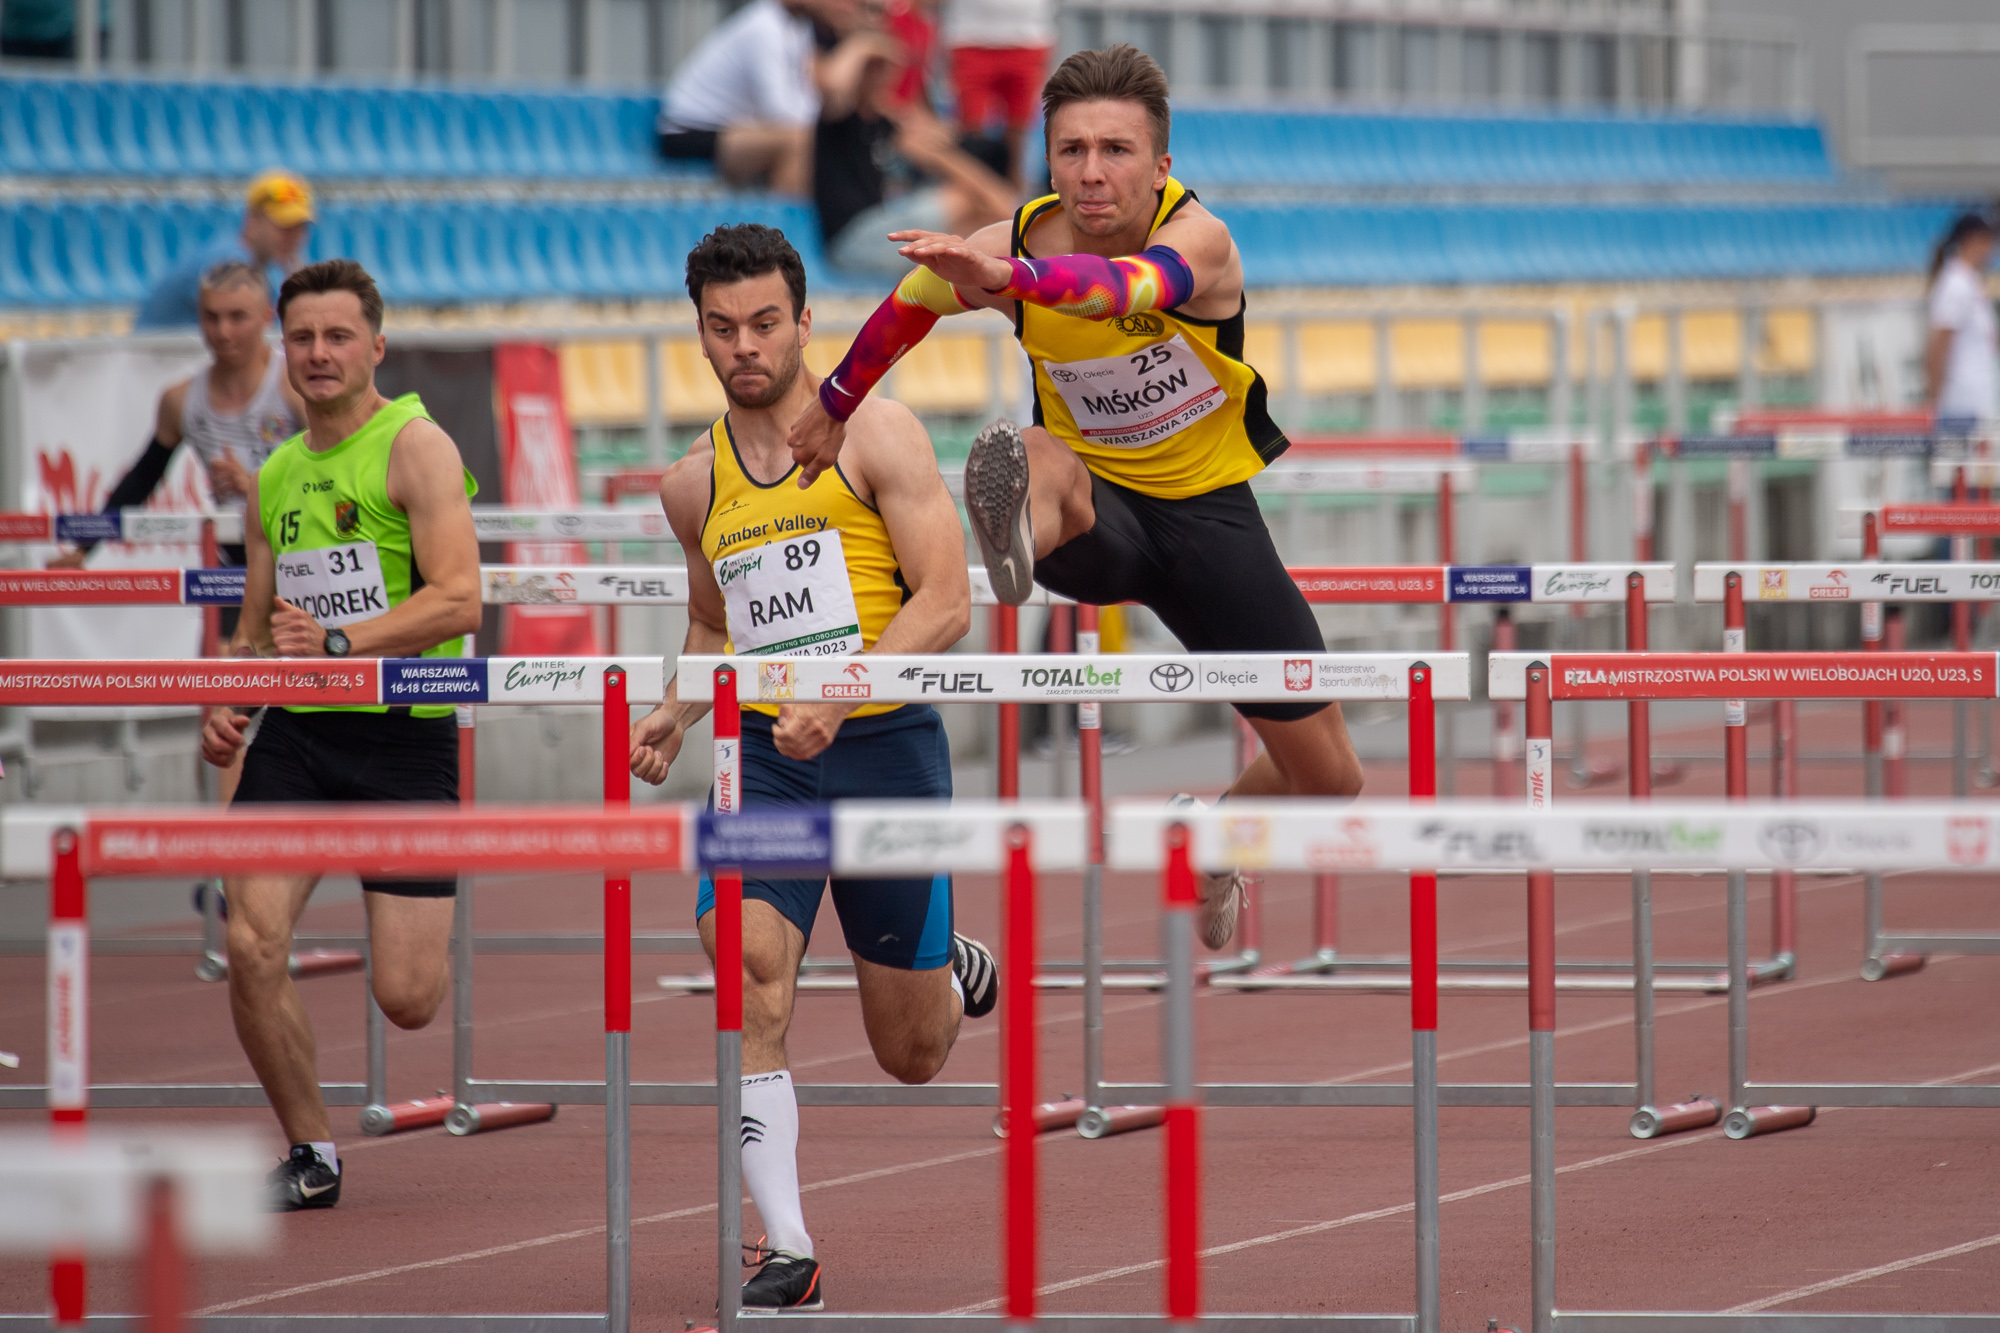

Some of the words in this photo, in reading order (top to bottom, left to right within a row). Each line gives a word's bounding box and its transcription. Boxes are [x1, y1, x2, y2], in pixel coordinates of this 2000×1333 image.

[1130, 345, 1172, 377] 25
[1083, 368, 1115, 379] Okęcie
[1081, 368, 1189, 416] MIŚKÓW
[1099, 419, 1181, 446] WARSZAWA
[1182, 400, 1214, 421] 2023
[1138, 411, 1154, 420] U23
[1140, 420, 1159, 430] POLSKI
[280, 509, 302, 546] 15
[717, 523, 769, 550] Amber
[774, 514, 828, 532] Valley
[328, 548, 364, 576] 31
[784, 539, 821, 571] 89
[284, 563, 314, 578] FUEL
[22, 580, 104, 592] WIELOBOJACH
[199, 575, 246, 584] WARSZAW
[1463, 574, 1516, 583] WARSZAWA
[1889, 578, 1948, 594] FUEL
[616, 581, 673, 597] FUEL
[1480, 585, 1526, 595] CZERWCA
[1810, 588, 1848, 598] ORLEN
[284, 586, 384, 619] CIOREK
[748, 587, 814, 628] RAM
[774, 640, 798, 650] MITYNG
[799, 628, 850, 645] WIELOBOJOWY
[814, 641, 848, 656] 2023
[531, 661, 565, 669] INTER
[1319, 664, 1376, 674] Ministerstwo
[401, 667, 468, 679] WARSZAWA
[504, 660, 586, 691] Europol
[898, 667, 924, 681] 4F
[921, 673, 994, 694] FUEL
[1021, 664, 1123, 687] TOTALbet
[1206, 671, 1258, 687] Okęcie
[1610, 669, 1716, 683] MISTRZOSTWA
[1719, 669, 1771, 682] POLSKI
[1773, 668, 1788, 681] W
[1791, 668, 1897, 681] WIELOBOJACH
[1901, 668, 1935, 683] U20,
[1937, 668, 1971, 683] U23,
[1972, 668, 1983, 681] S
[0, 675, 102, 689] MISTRZOSTWA
[106, 675, 157, 689] POLSKI
[160, 675, 174, 688] W
[177, 675, 281, 688] WIELOBOJACH
[355, 675, 365, 687] S
[390, 684, 420, 694] 16-18
[422, 682, 480, 694] CZERWCA
[1319, 677, 1350, 688] Sportu
[824, 686, 868, 697] ORLEN
[717, 771, 732, 816] lanik
